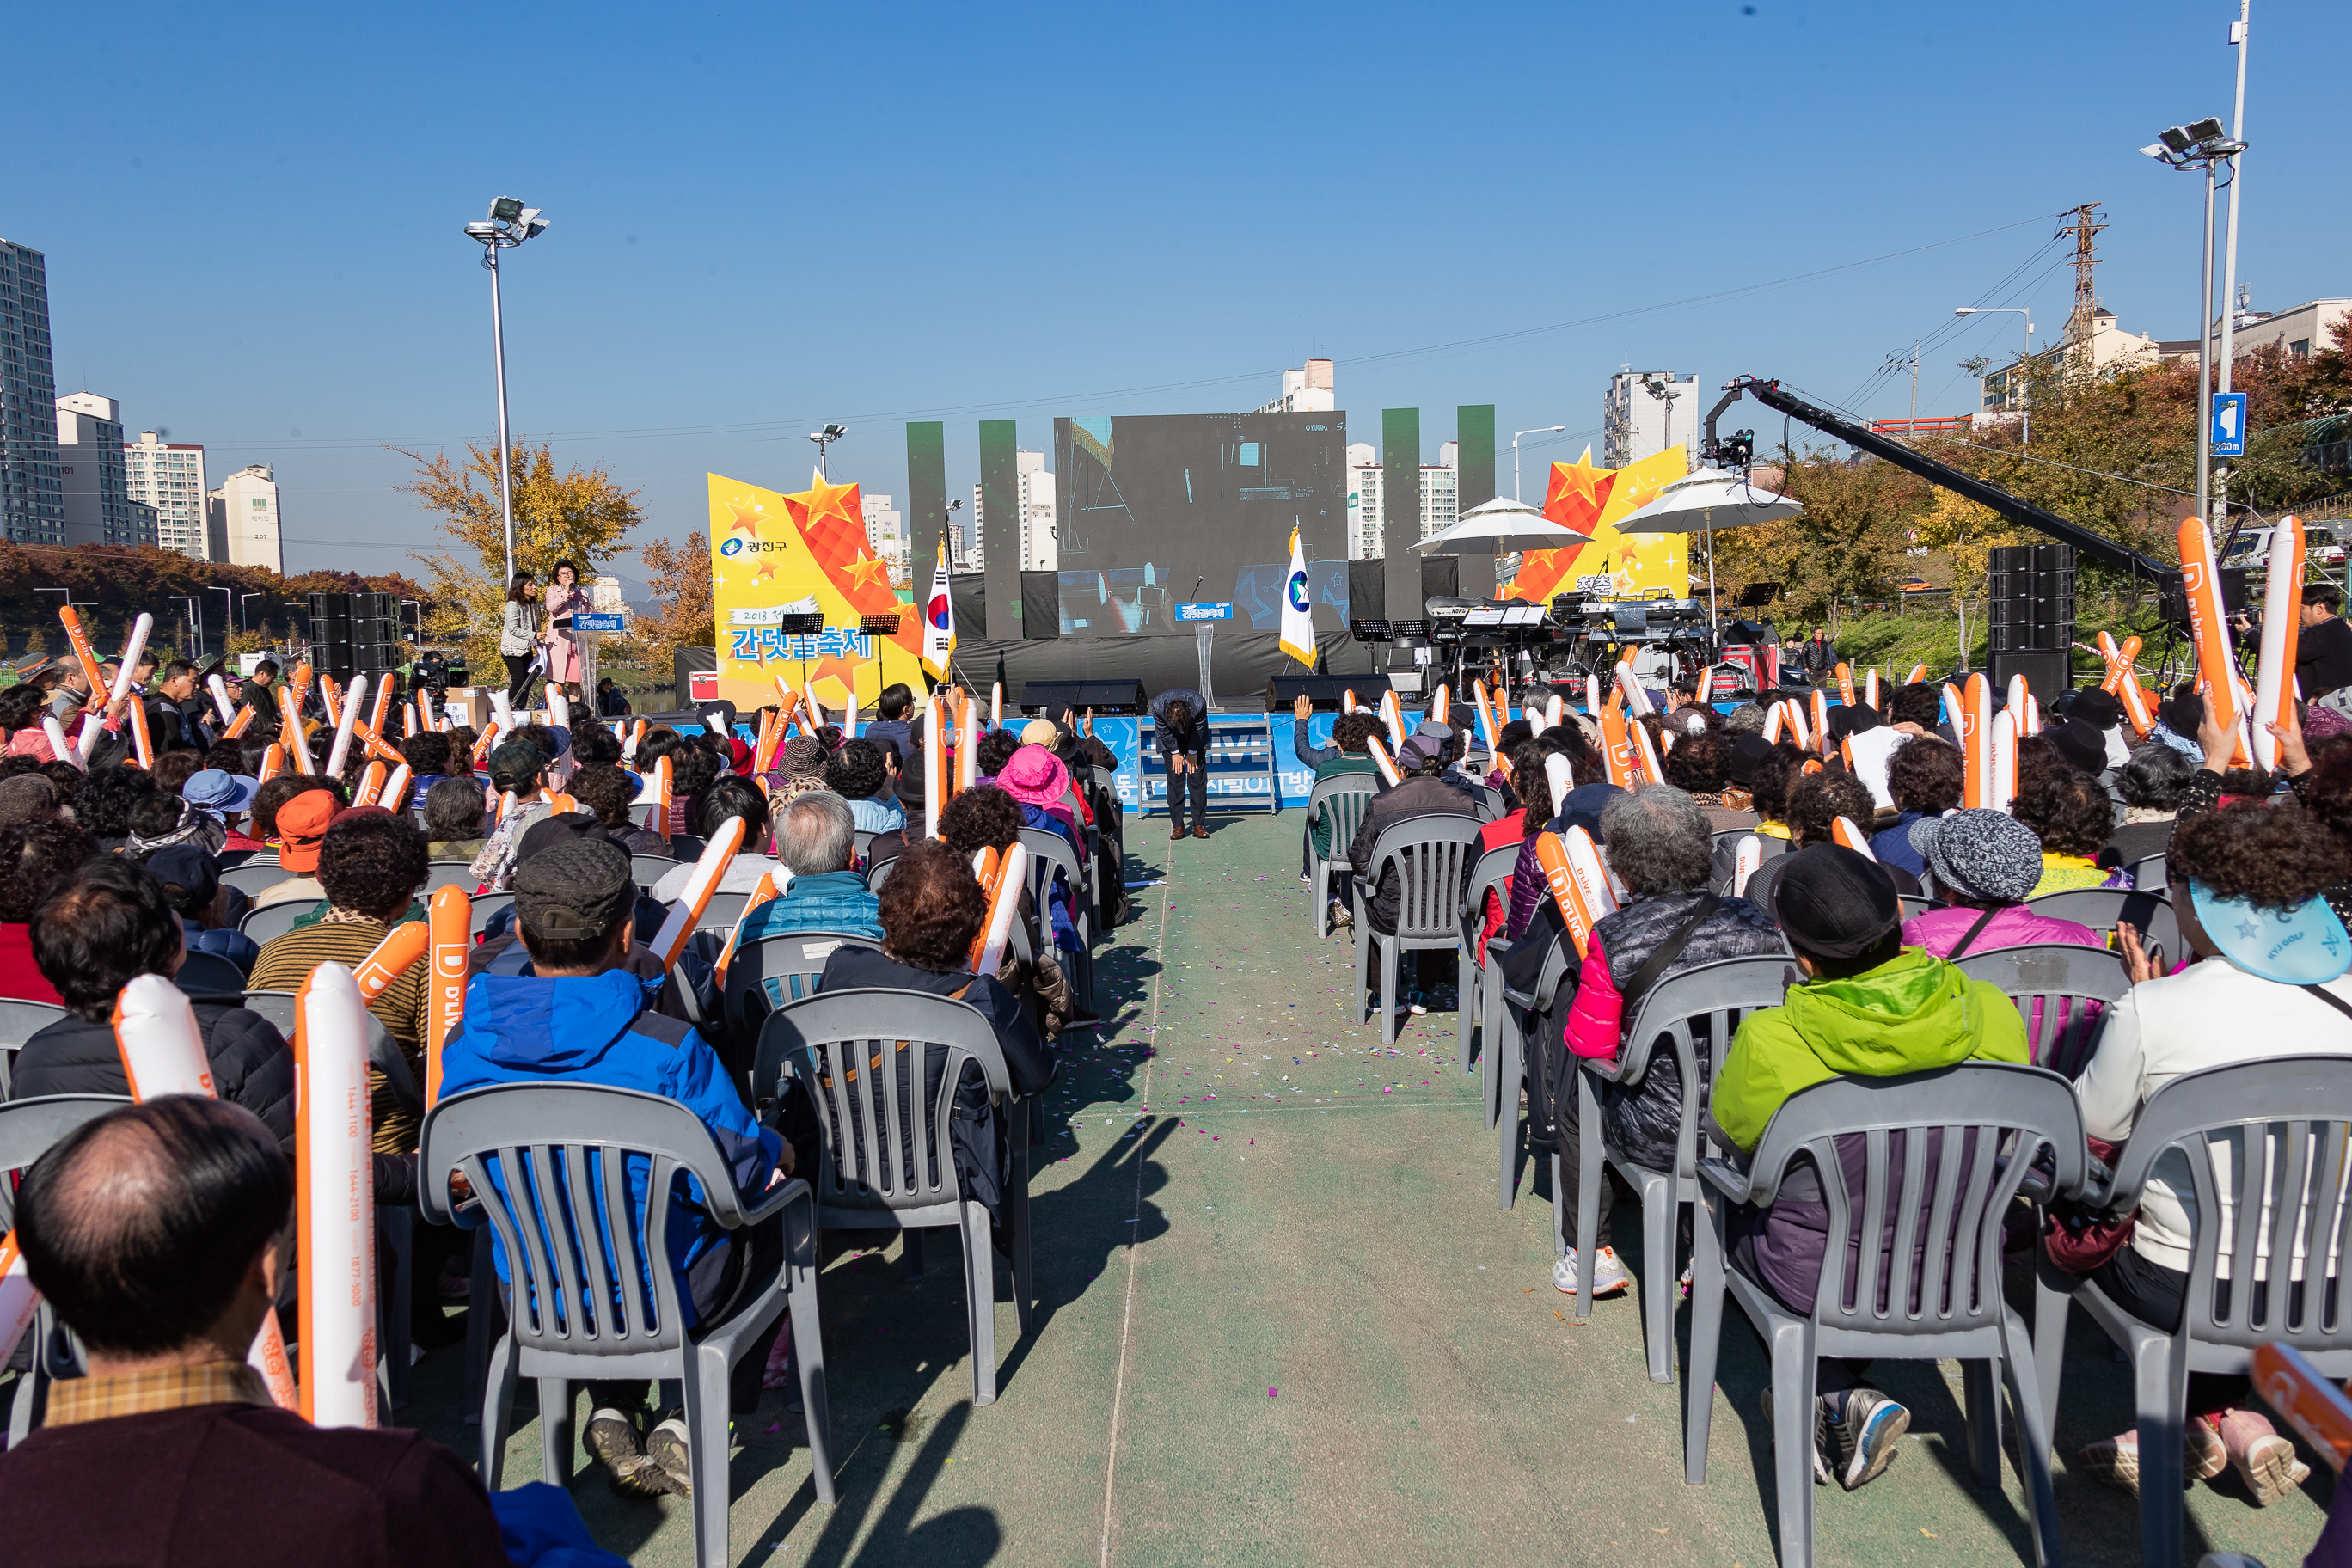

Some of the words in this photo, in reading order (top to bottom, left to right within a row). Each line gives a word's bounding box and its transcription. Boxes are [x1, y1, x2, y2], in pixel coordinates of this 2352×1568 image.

[61, 466, 74, 475] 101
[746, 542, 787, 553] 광진구
[744, 611, 767, 621] 2018
[2267, 944, 2283, 959] KYJ
[2282, 931, 2304, 946] GOLF
[348, 1087, 358, 1138] 1644-1100
[350, 1169, 360, 1222] 1644-2100
[352, 1255, 362, 1308] 1877-5000
